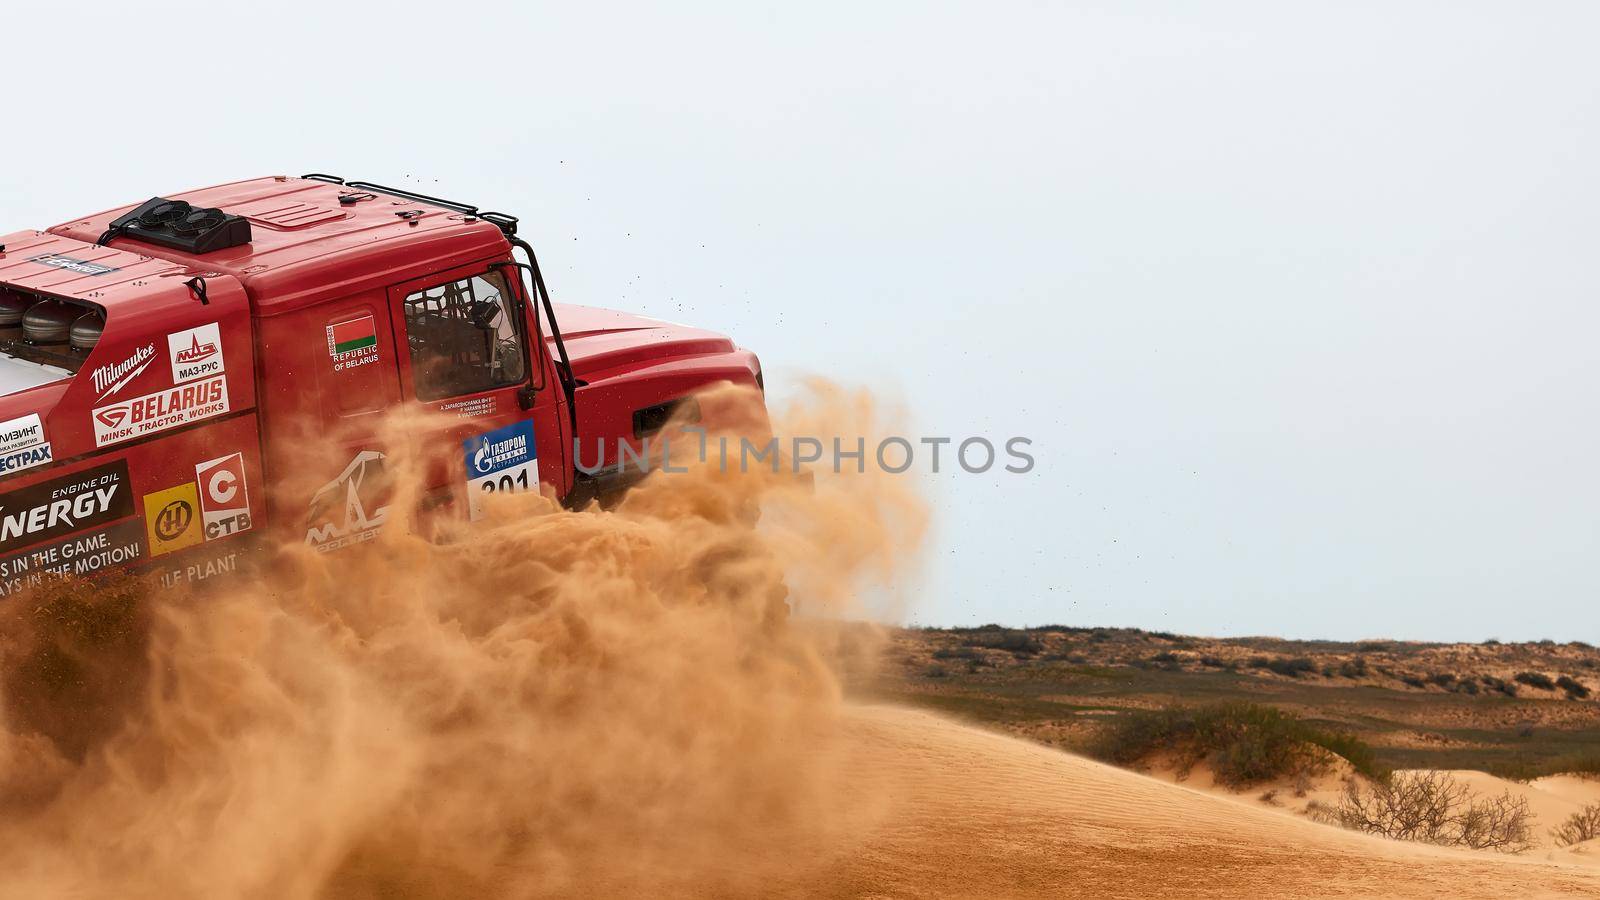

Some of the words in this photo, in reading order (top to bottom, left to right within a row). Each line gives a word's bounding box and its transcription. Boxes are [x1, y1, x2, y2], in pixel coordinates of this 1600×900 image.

[89, 342, 154, 393] Milwaukee
[333, 345, 377, 362] REPUBLIC
[334, 362, 345, 371] OF
[345, 354, 379, 369] BELARUS
[179, 361, 219, 379] МАЗ-РУС
[130, 379, 223, 424] BELARUS
[100, 426, 134, 443] MINSK
[138, 413, 184, 432] TRACTOR
[189, 402, 225, 419] WORKS
[11, 437, 38, 449] РАЗВИТИЯ
[491, 434, 526, 456] ГАЗПРОМ
[52, 479, 98, 499] ENGINE
[100, 472, 120, 486] OIL
[0, 483, 118, 542] NERGY
[13, 556, 29, 574] IN
[31, 548, 58, 567] THE
[61, 533, 111, 559] GAME.
[75, 542, 140, 575] MOTION!
[187, 554, 236, 582] PLANT
